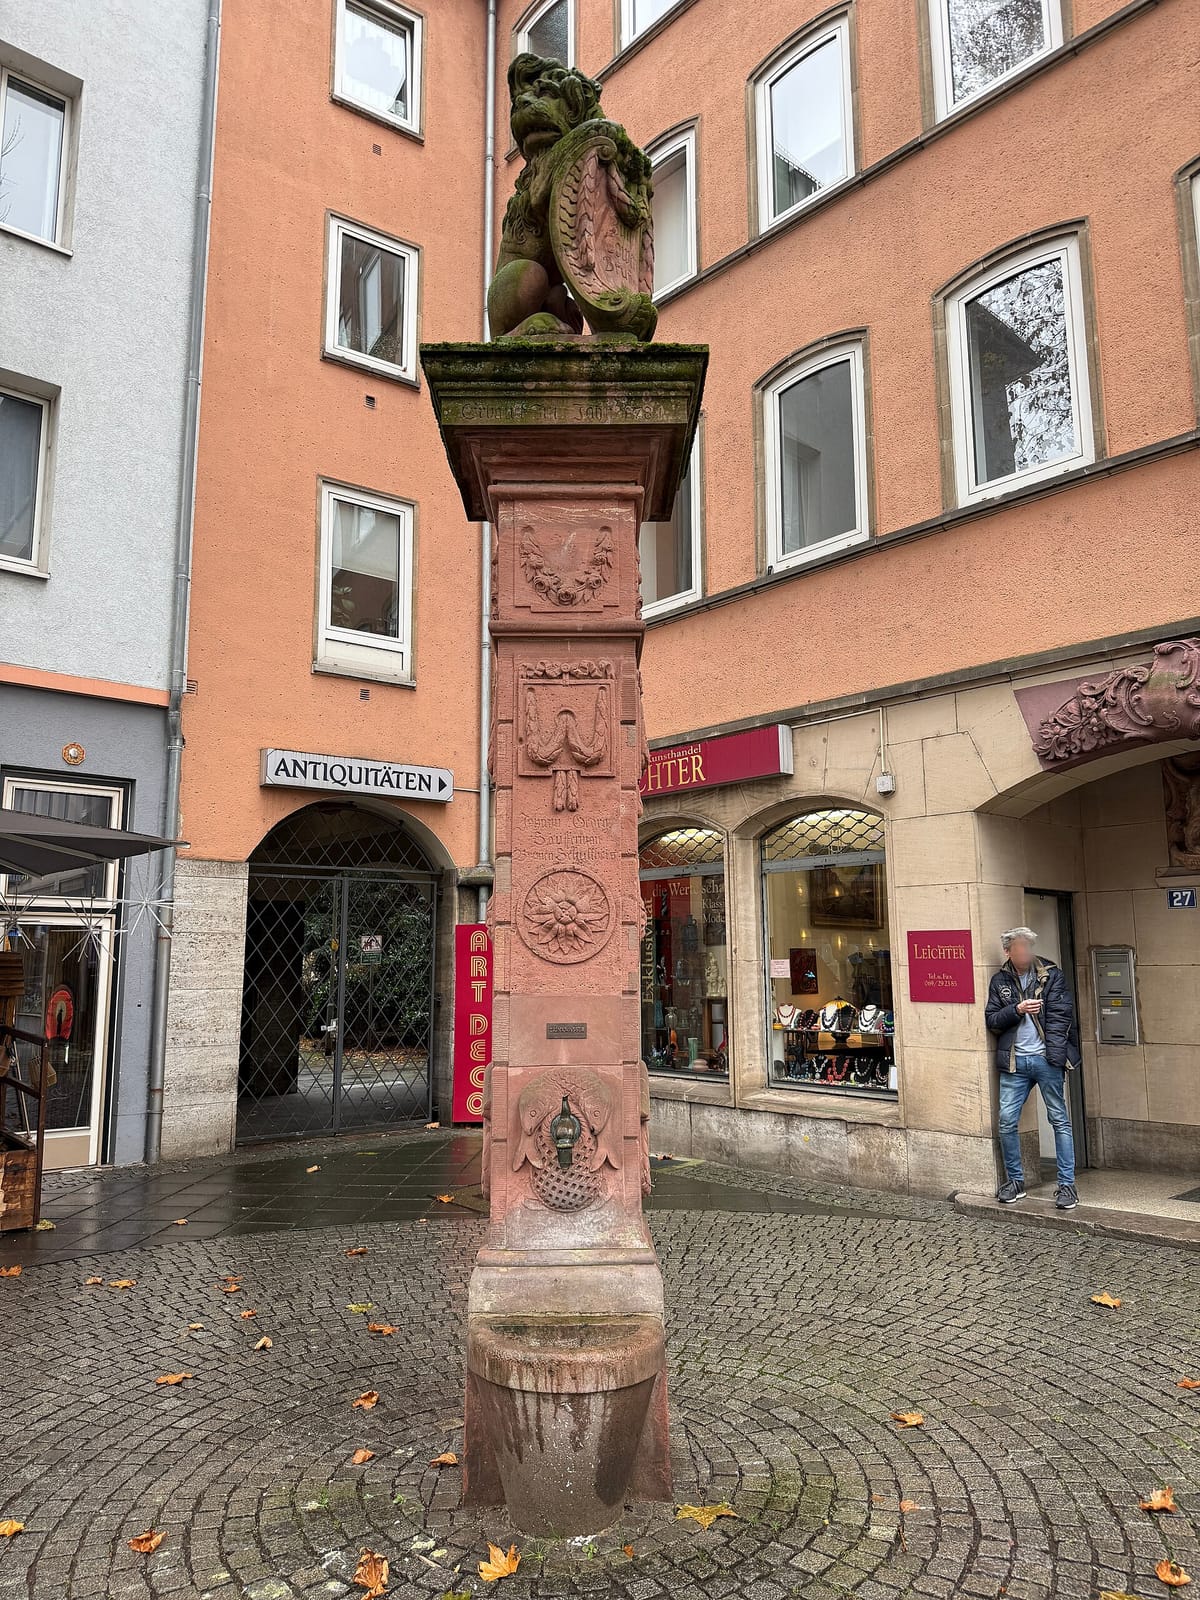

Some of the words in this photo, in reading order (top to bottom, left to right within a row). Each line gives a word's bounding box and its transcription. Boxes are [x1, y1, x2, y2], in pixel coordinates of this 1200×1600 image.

[274, 757, 432, 793] ANTIQUITÄTEN
[1172, 891, 1192, 906] 27
[470, 930, 488, 1003] ART
[466, 1013, 489, 1116] DECO
